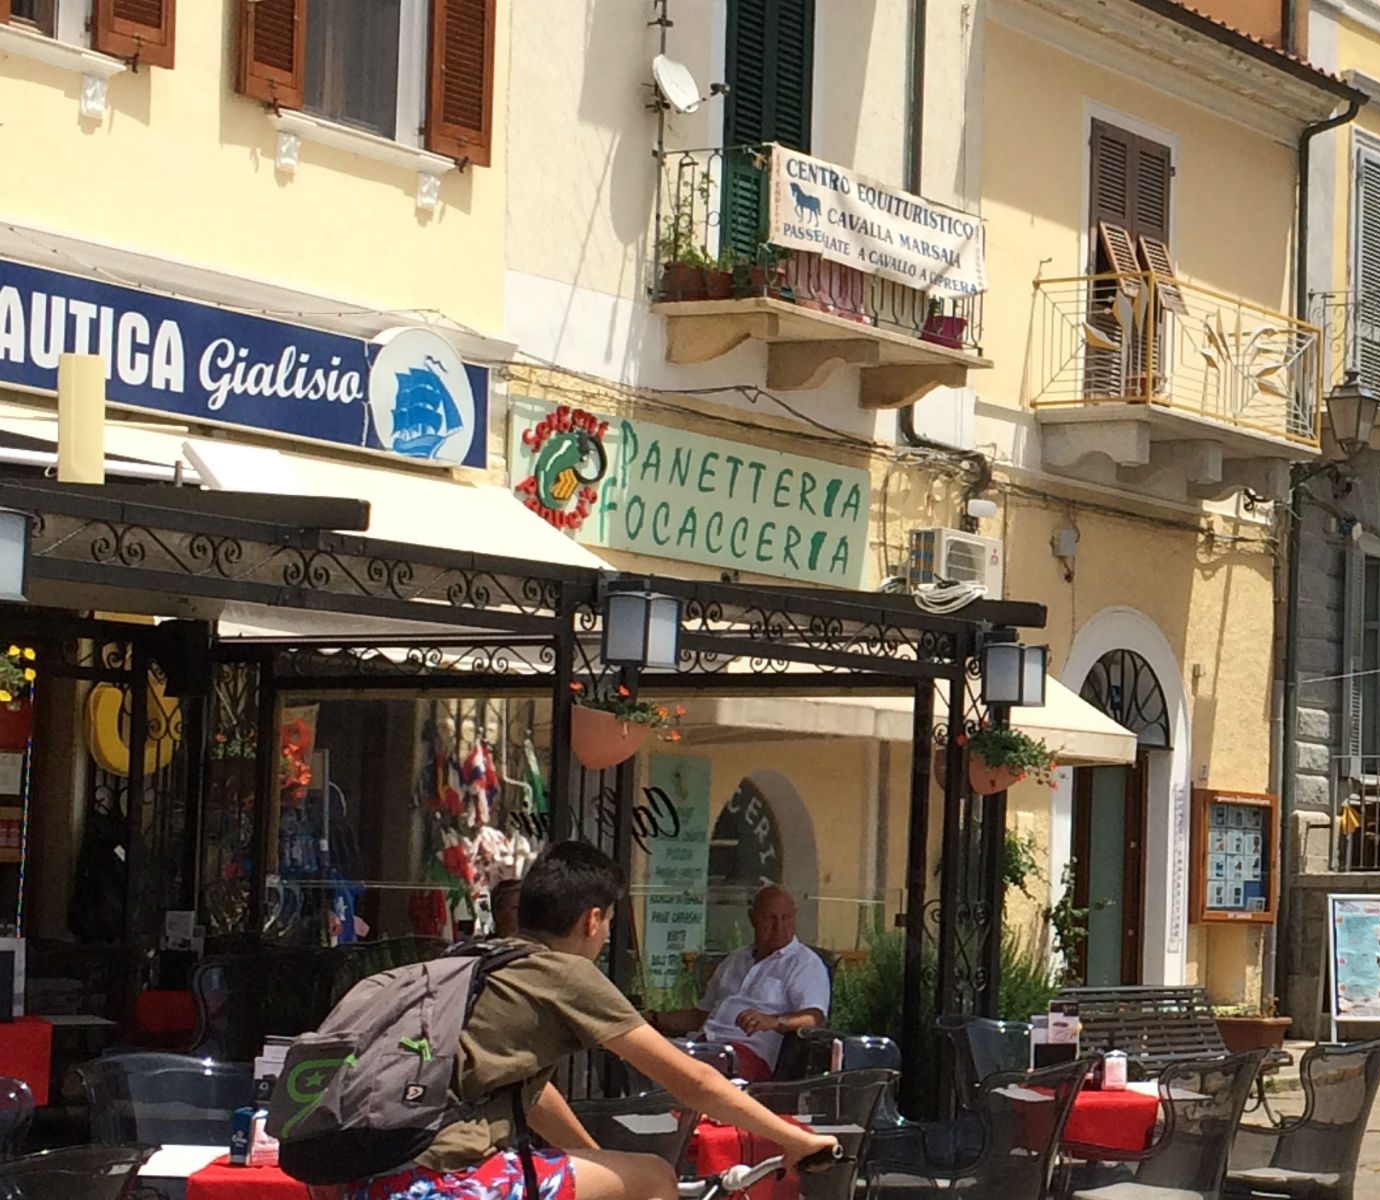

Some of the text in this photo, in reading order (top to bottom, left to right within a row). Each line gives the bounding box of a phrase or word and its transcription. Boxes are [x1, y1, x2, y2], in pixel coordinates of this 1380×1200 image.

[786, 157, 850, 195] CENTRO
[857, 182, 974, 241] EQUITURISTICO
[827, 207, 894, 245] CAVALLA
[783, 222, 850, 256] PASSEIATE
[858, 247, 866, 262] A
[868, 250, 917, 278] CAVALLO
[920, 268, 927, 281] A
[0, 284, 363, 411] AUTICA Gialisio
[621, 419, 861, 522] PANETTERIA
[599, 476, 850, 575] FOCACCERIA
